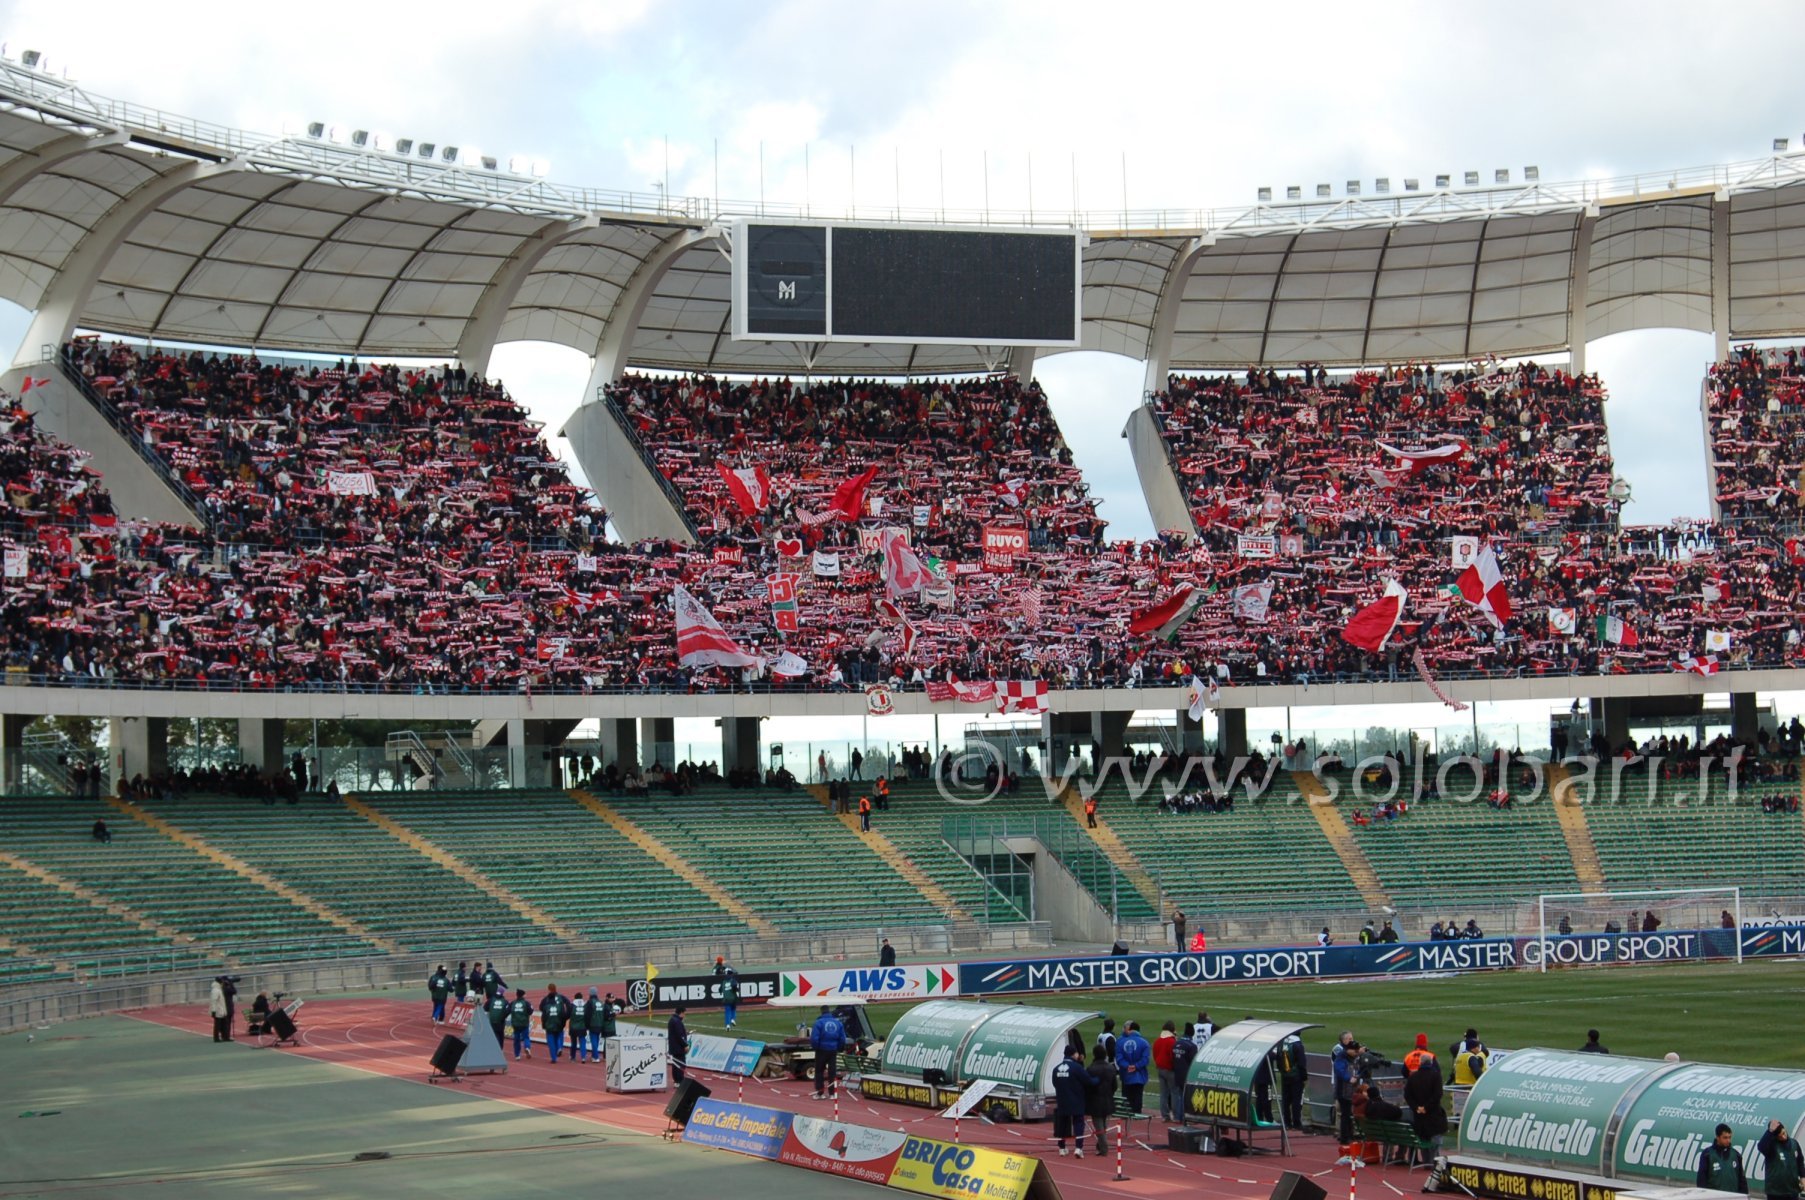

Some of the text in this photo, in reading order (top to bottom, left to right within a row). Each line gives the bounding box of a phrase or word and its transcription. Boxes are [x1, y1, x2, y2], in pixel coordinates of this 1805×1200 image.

[987, 534, 1024, 548] RUVO
[1419, 934, 1695, 969] MASTER GROUP SPORT
[1782, 930, 1805, 953] M
[838, 968, 906, 993] AWS
[1028, 950, 1326, 988] MASTER GROUP SPORT
[659, 984, 706, 1001] MB
[711, 981, 774, 999] SDE
[886, 1034, 953, 1071] Gaudianello
[964, 1042, 1039, 1082] Gaudianello
[1499, 1052, 1645, 1084] Gaudianello
[1497, 1087, 1595, 1108] EFFERVESCENTE NATURALE
[1519, 1079, 1588, 1095] ACQUA MINERALE
[1206, 1090, 1239, 1118] errea
[1657, 1105, 1769, 1127] EFFERVESCENTE NATURALE
[1682, 1097, 1760, 1113] ACQUA MINERALE
[692, 1108, 715, 1126] Gran
[714, 1111, 740, 1131] Caffè
[740, 1115, 785, 1139] Imperiale
[1466, 1099, 1597, 1156] Gaudianello
[932, 1147, 984, 1195] Casa
[1004, 1157, 1023, 1172] Bari
[984, 1182, 1018, 1200] Molfetta
[1451, 1166, 1576, 1200] errea errea errea
